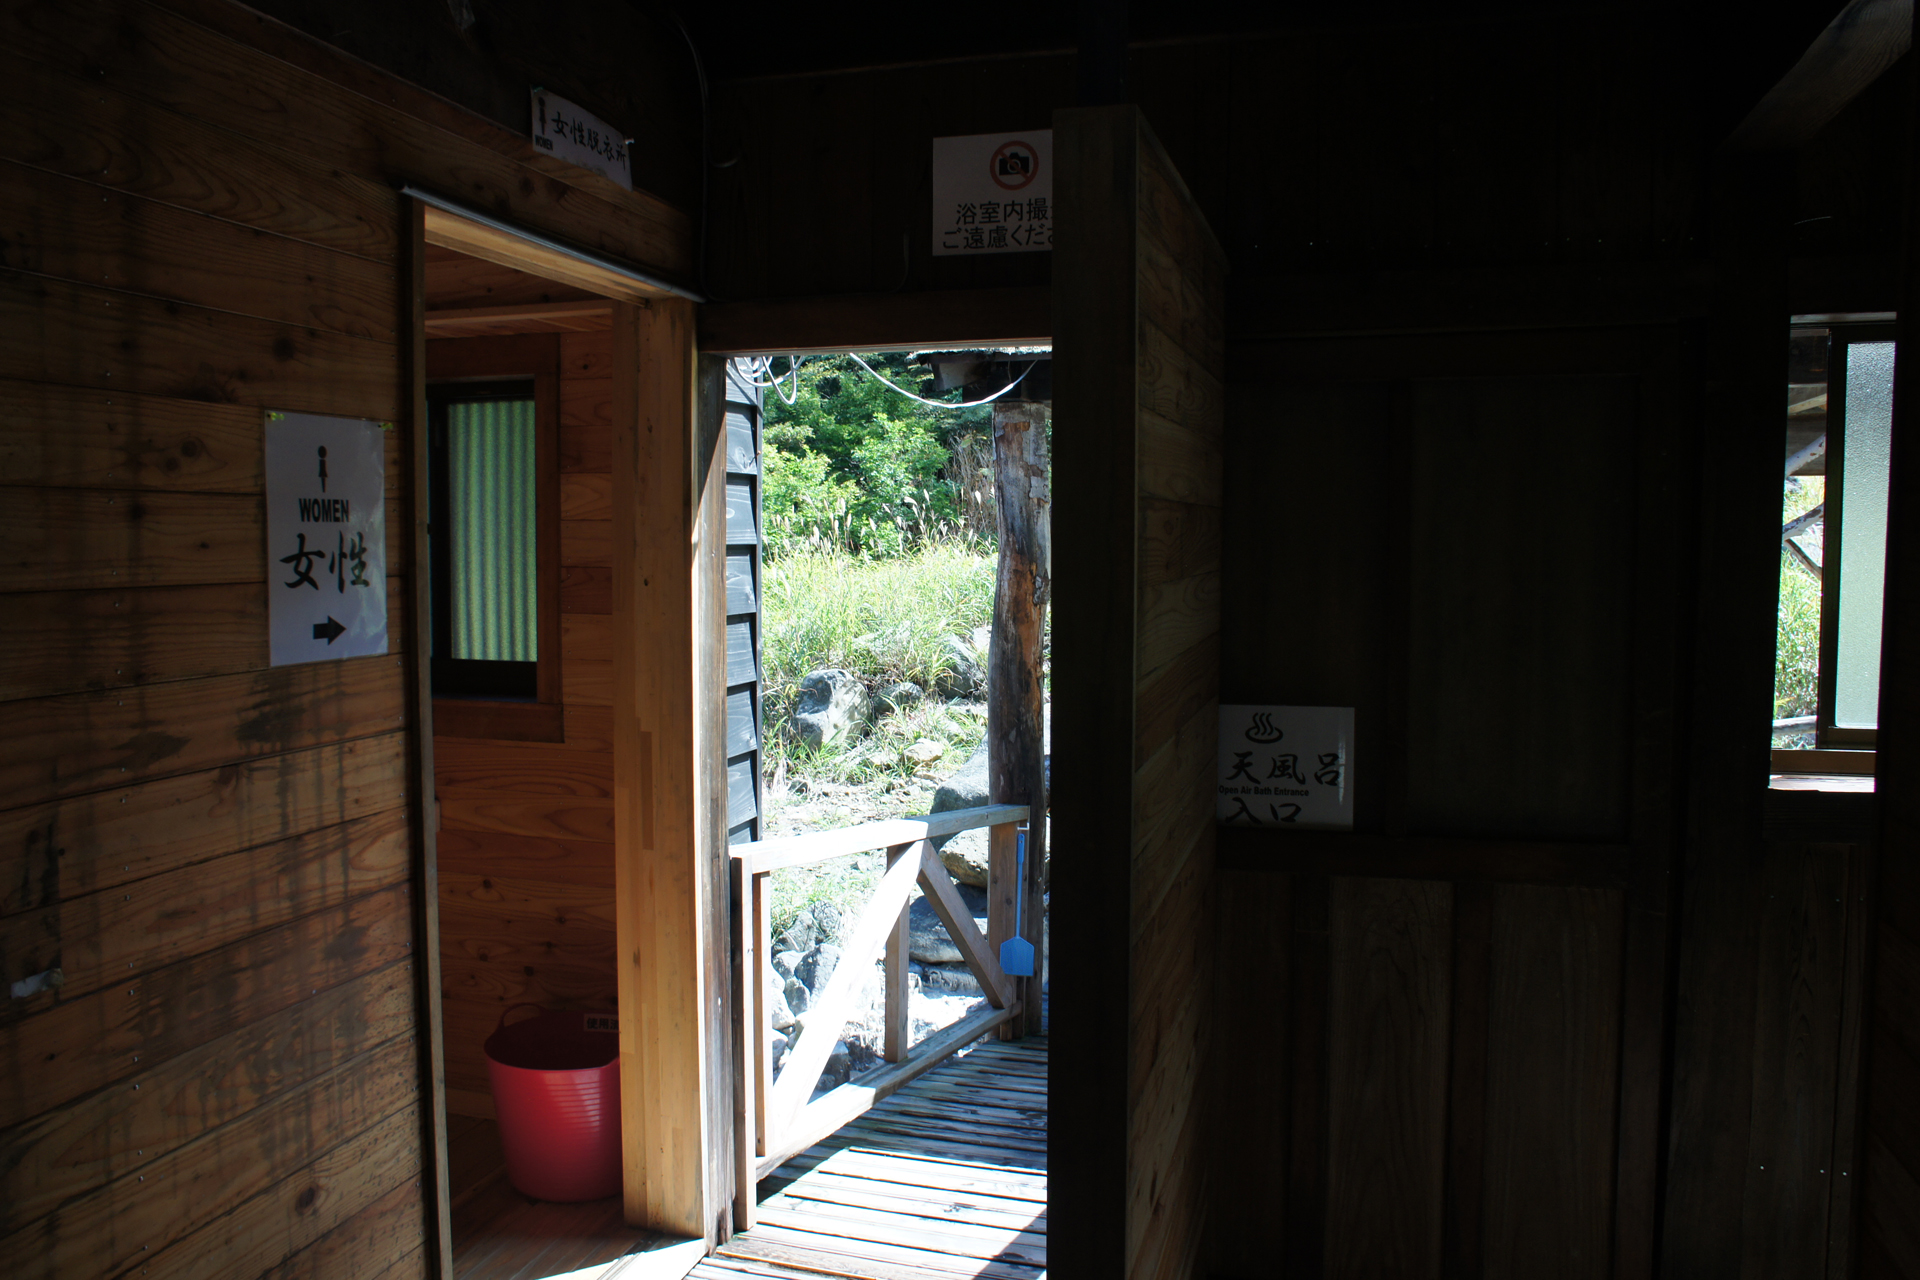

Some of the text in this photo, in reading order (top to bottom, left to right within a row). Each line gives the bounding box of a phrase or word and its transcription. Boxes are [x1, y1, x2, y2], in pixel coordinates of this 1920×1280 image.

[534, 134, 553, 151] WOMEN
[551, 111, 627, 171] 女性脱衣所
[956, 197, 1052, 225] 浴室内撮
[943, 223, 1052, 249] ご遠慮くだ
[299, 498, 350, 522] WOMEN
[279, 531, 370, 594] 女性
[1225, 751, 1340, 786] 天風呂
[1218, 785, 1309, 796] Open Air Bath Entrance
[1225, 797, 1302, 825] 入口
